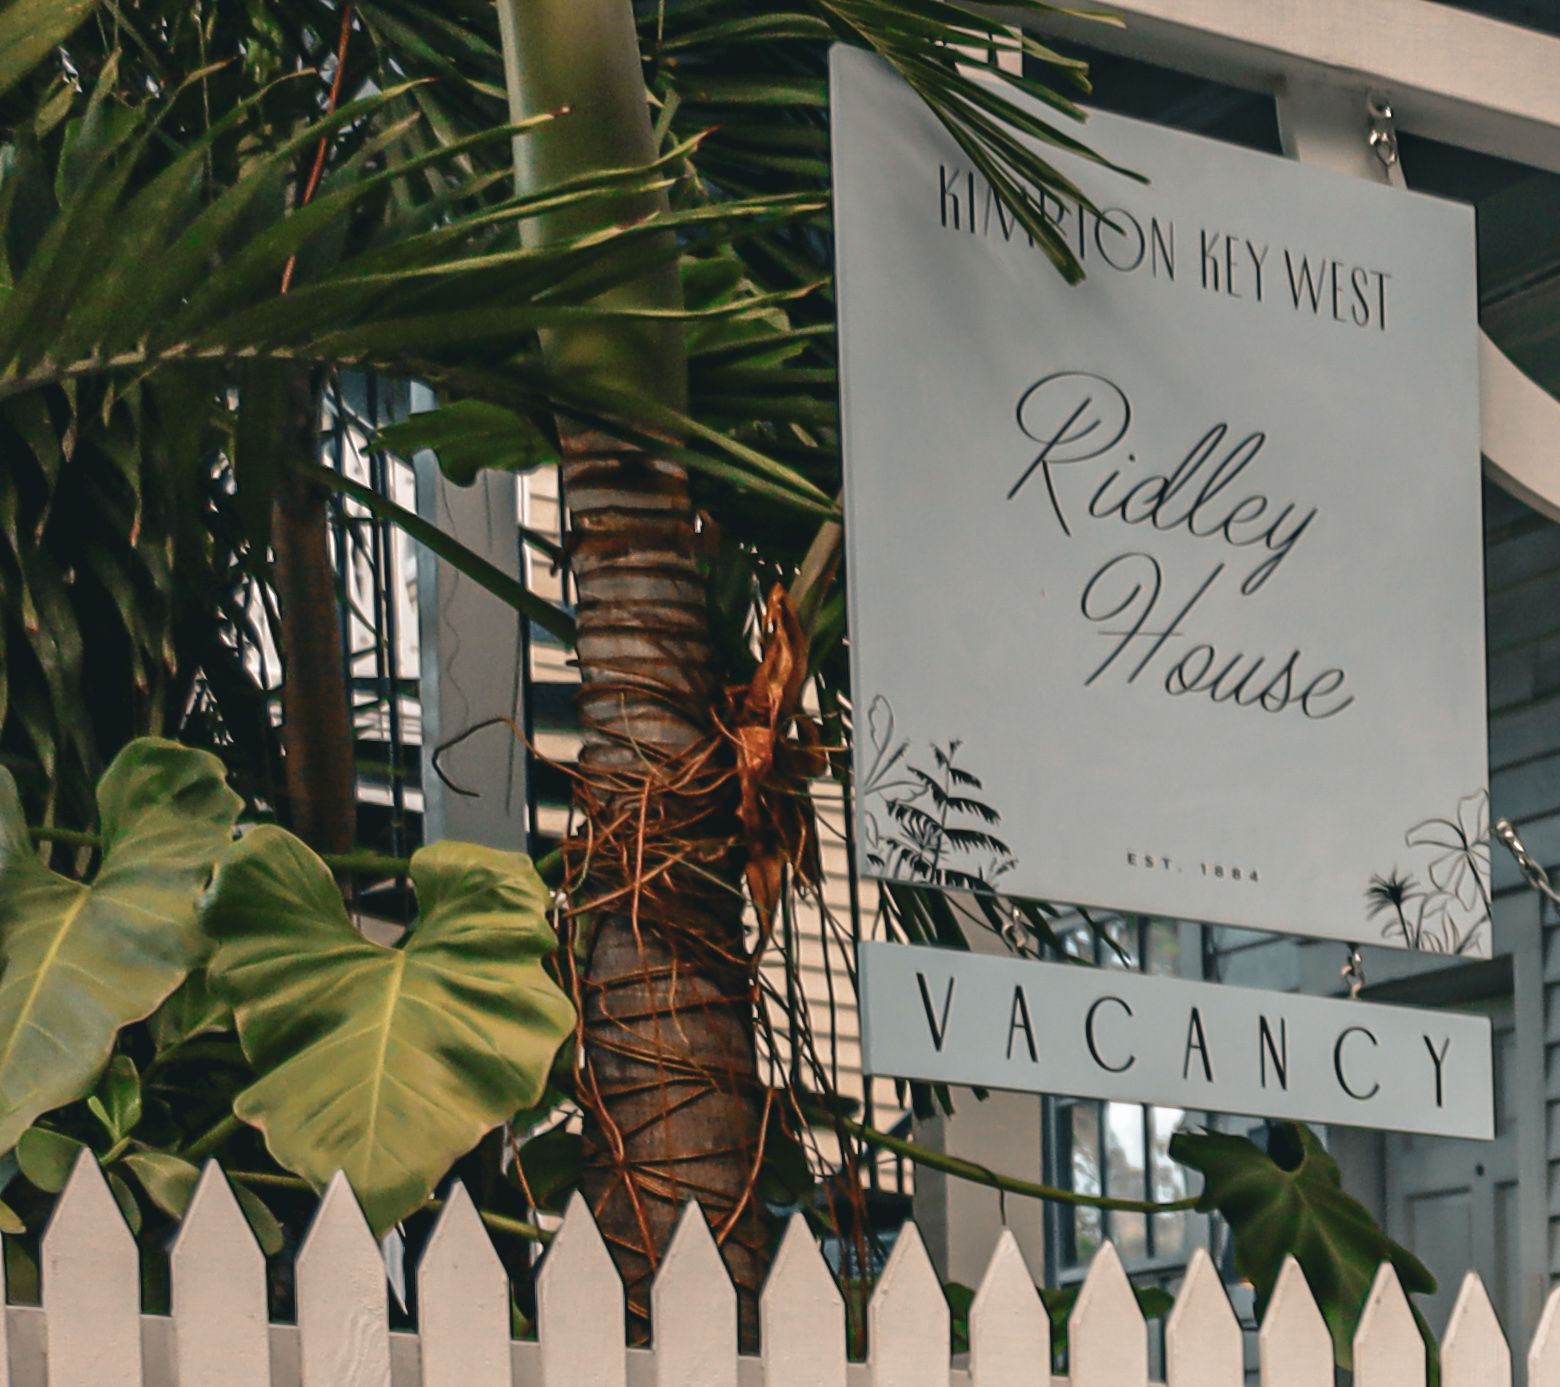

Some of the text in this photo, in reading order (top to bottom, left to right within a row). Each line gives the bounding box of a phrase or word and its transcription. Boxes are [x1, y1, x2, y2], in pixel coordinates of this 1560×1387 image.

[1200, 228, 1269, 302] KEY
[1284, 250, 1393, 331] WEST
[1006, 370, 1318, 597] Ridley
[1080, 551, 1355, 720] House
[1126, 852, 1259, 883] EST. 1884
[916, 971, 1451, 1108] VACANCY
